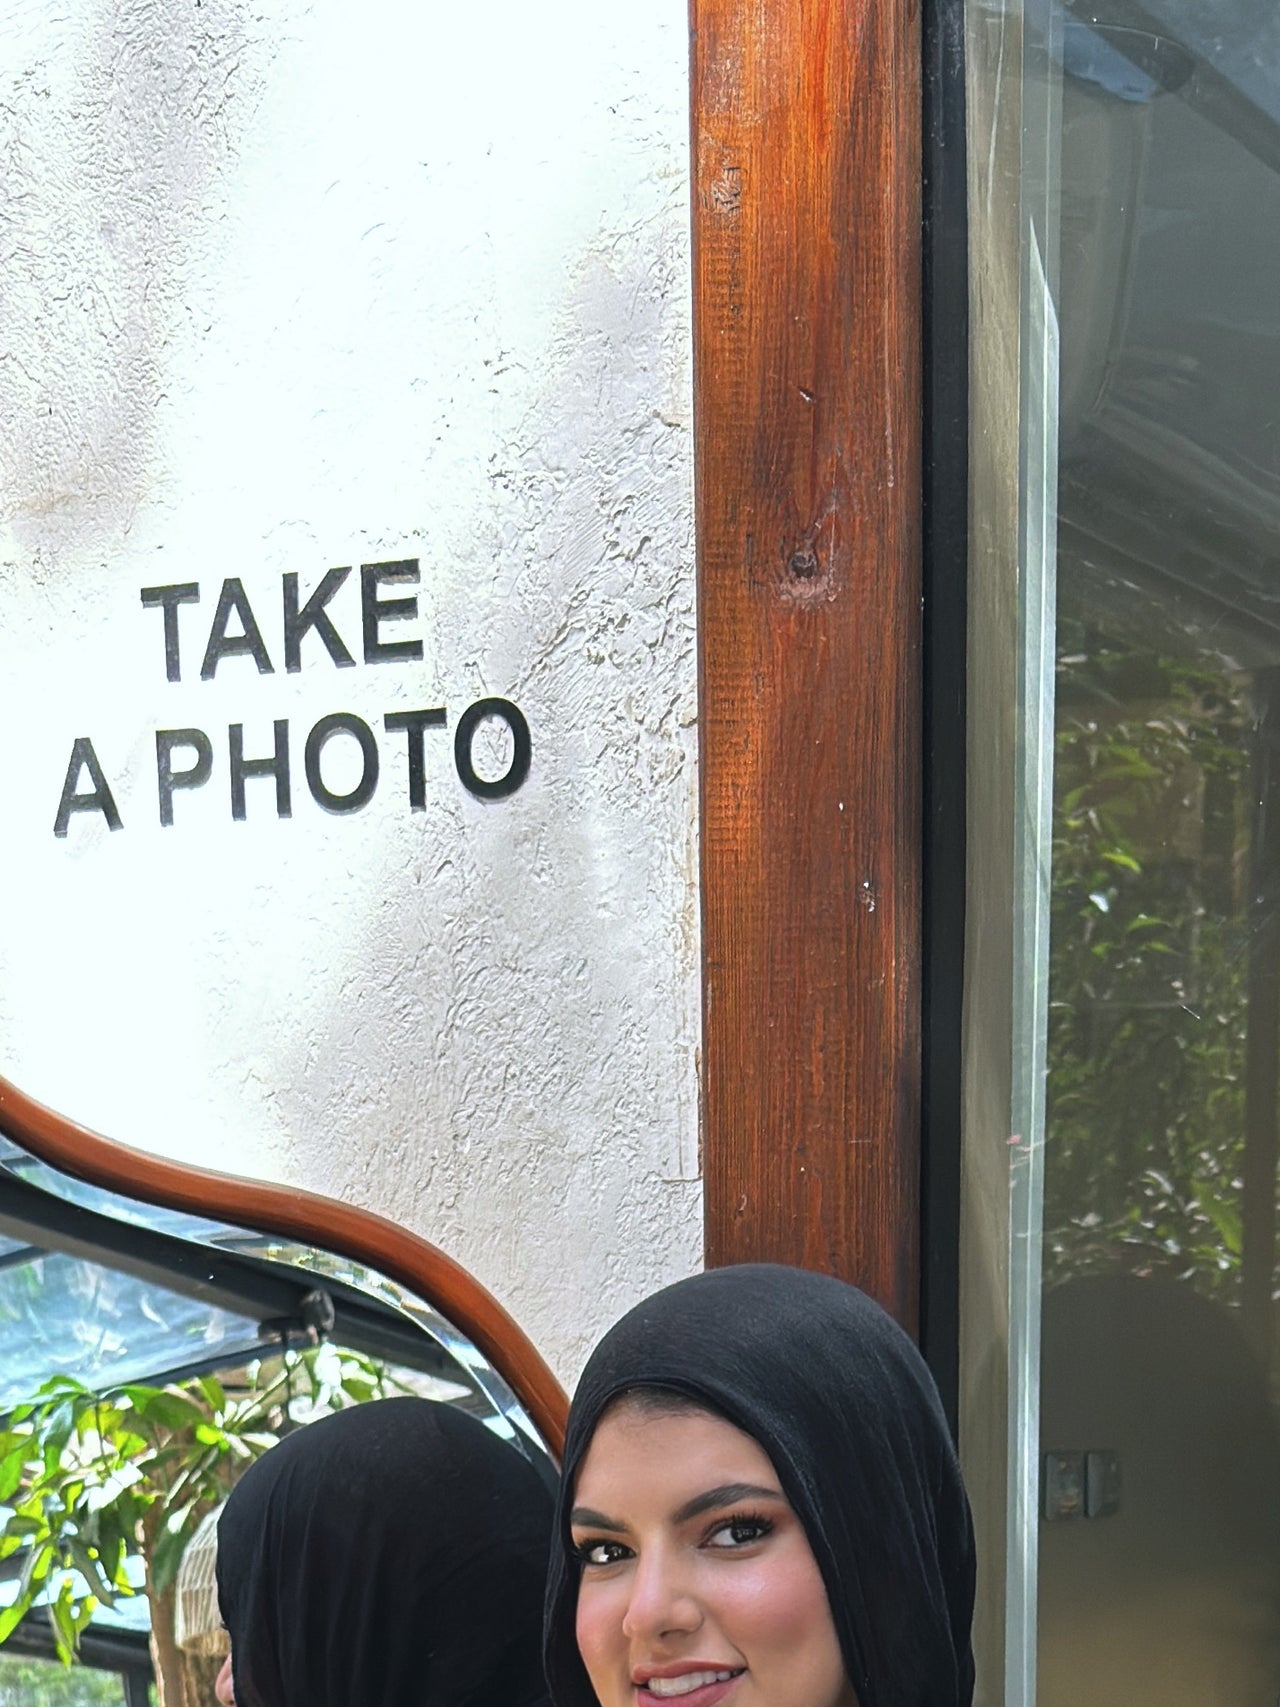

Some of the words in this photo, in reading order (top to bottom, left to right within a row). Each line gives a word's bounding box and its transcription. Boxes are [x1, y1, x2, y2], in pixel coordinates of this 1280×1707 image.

[140, 558, 424, 682] TAKE
[53, 736, 124, 838] A
[155, 697, 533, 828] PHOTO
